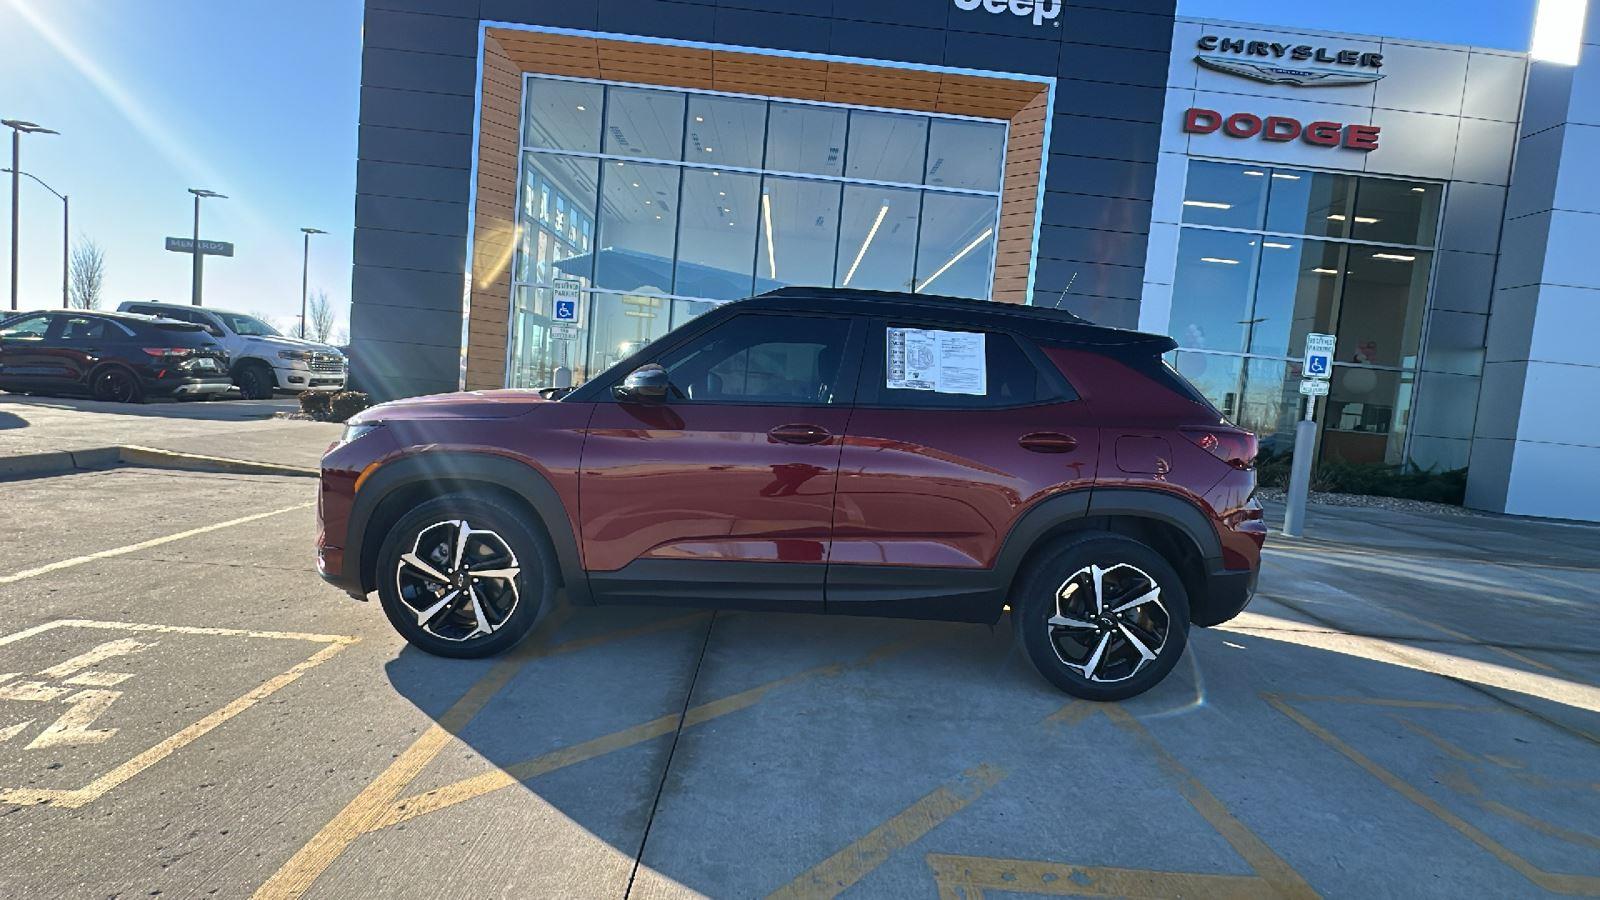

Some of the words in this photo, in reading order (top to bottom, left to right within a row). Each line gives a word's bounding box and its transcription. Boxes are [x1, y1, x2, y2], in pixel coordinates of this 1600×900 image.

[954, 0, 1061, 26] eep
[1199, 35, 1384, 68] CHRYSLER
[1184, 107, 1381, 151] DODGE
